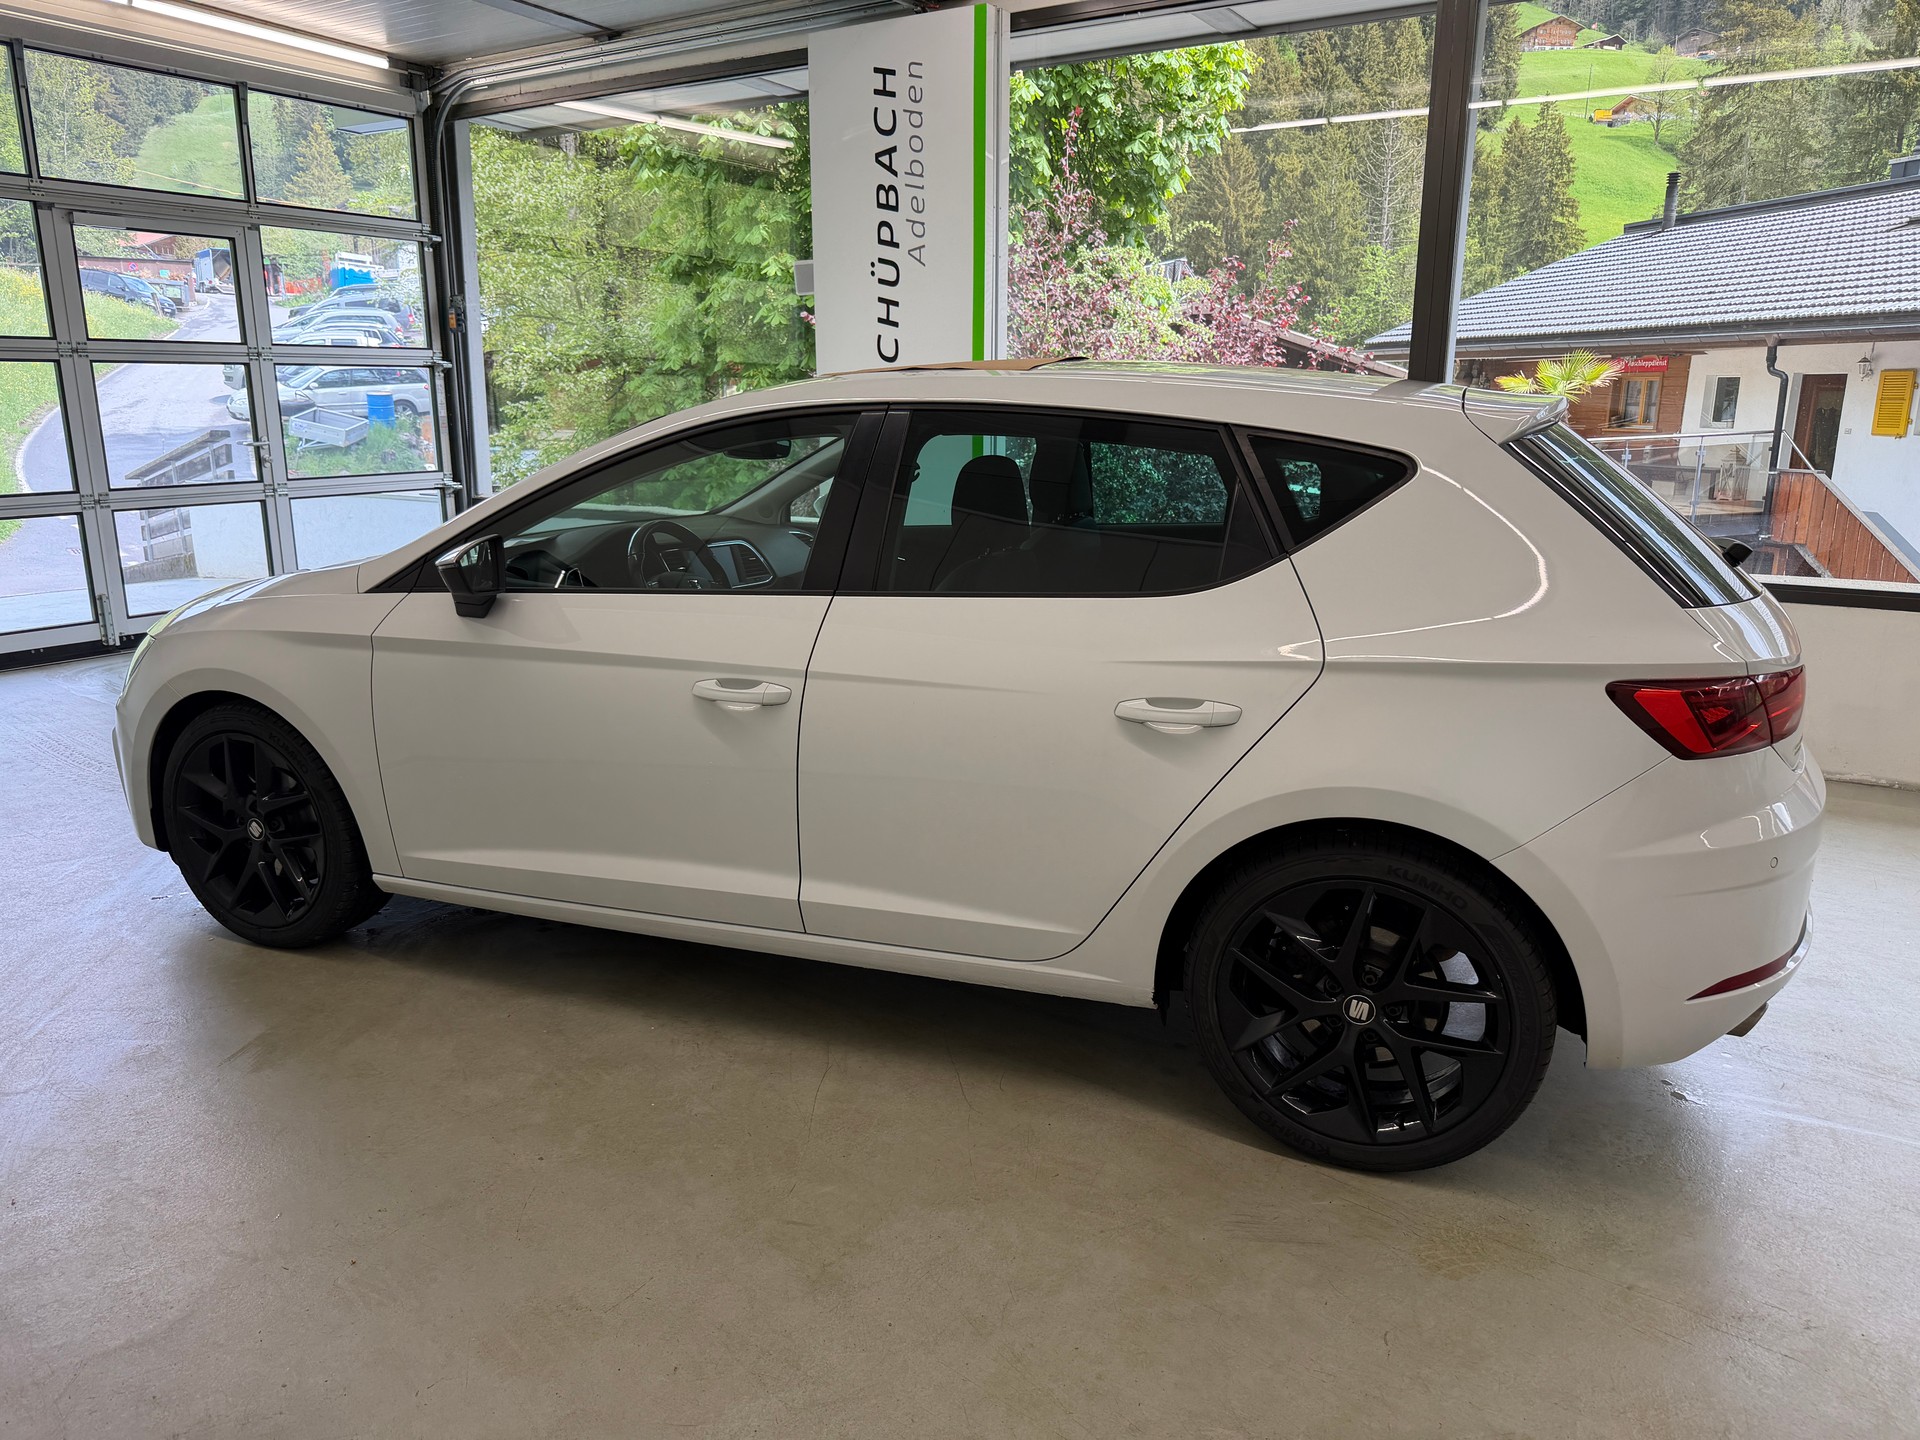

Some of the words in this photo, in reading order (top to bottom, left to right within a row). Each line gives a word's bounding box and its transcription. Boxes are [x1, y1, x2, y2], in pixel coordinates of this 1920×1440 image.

[870, 66, 900, 364] CHÜPBACH
[903, 61, 926, 267] Adelboden
[1386, 864, 1467, 910] KUMHO
